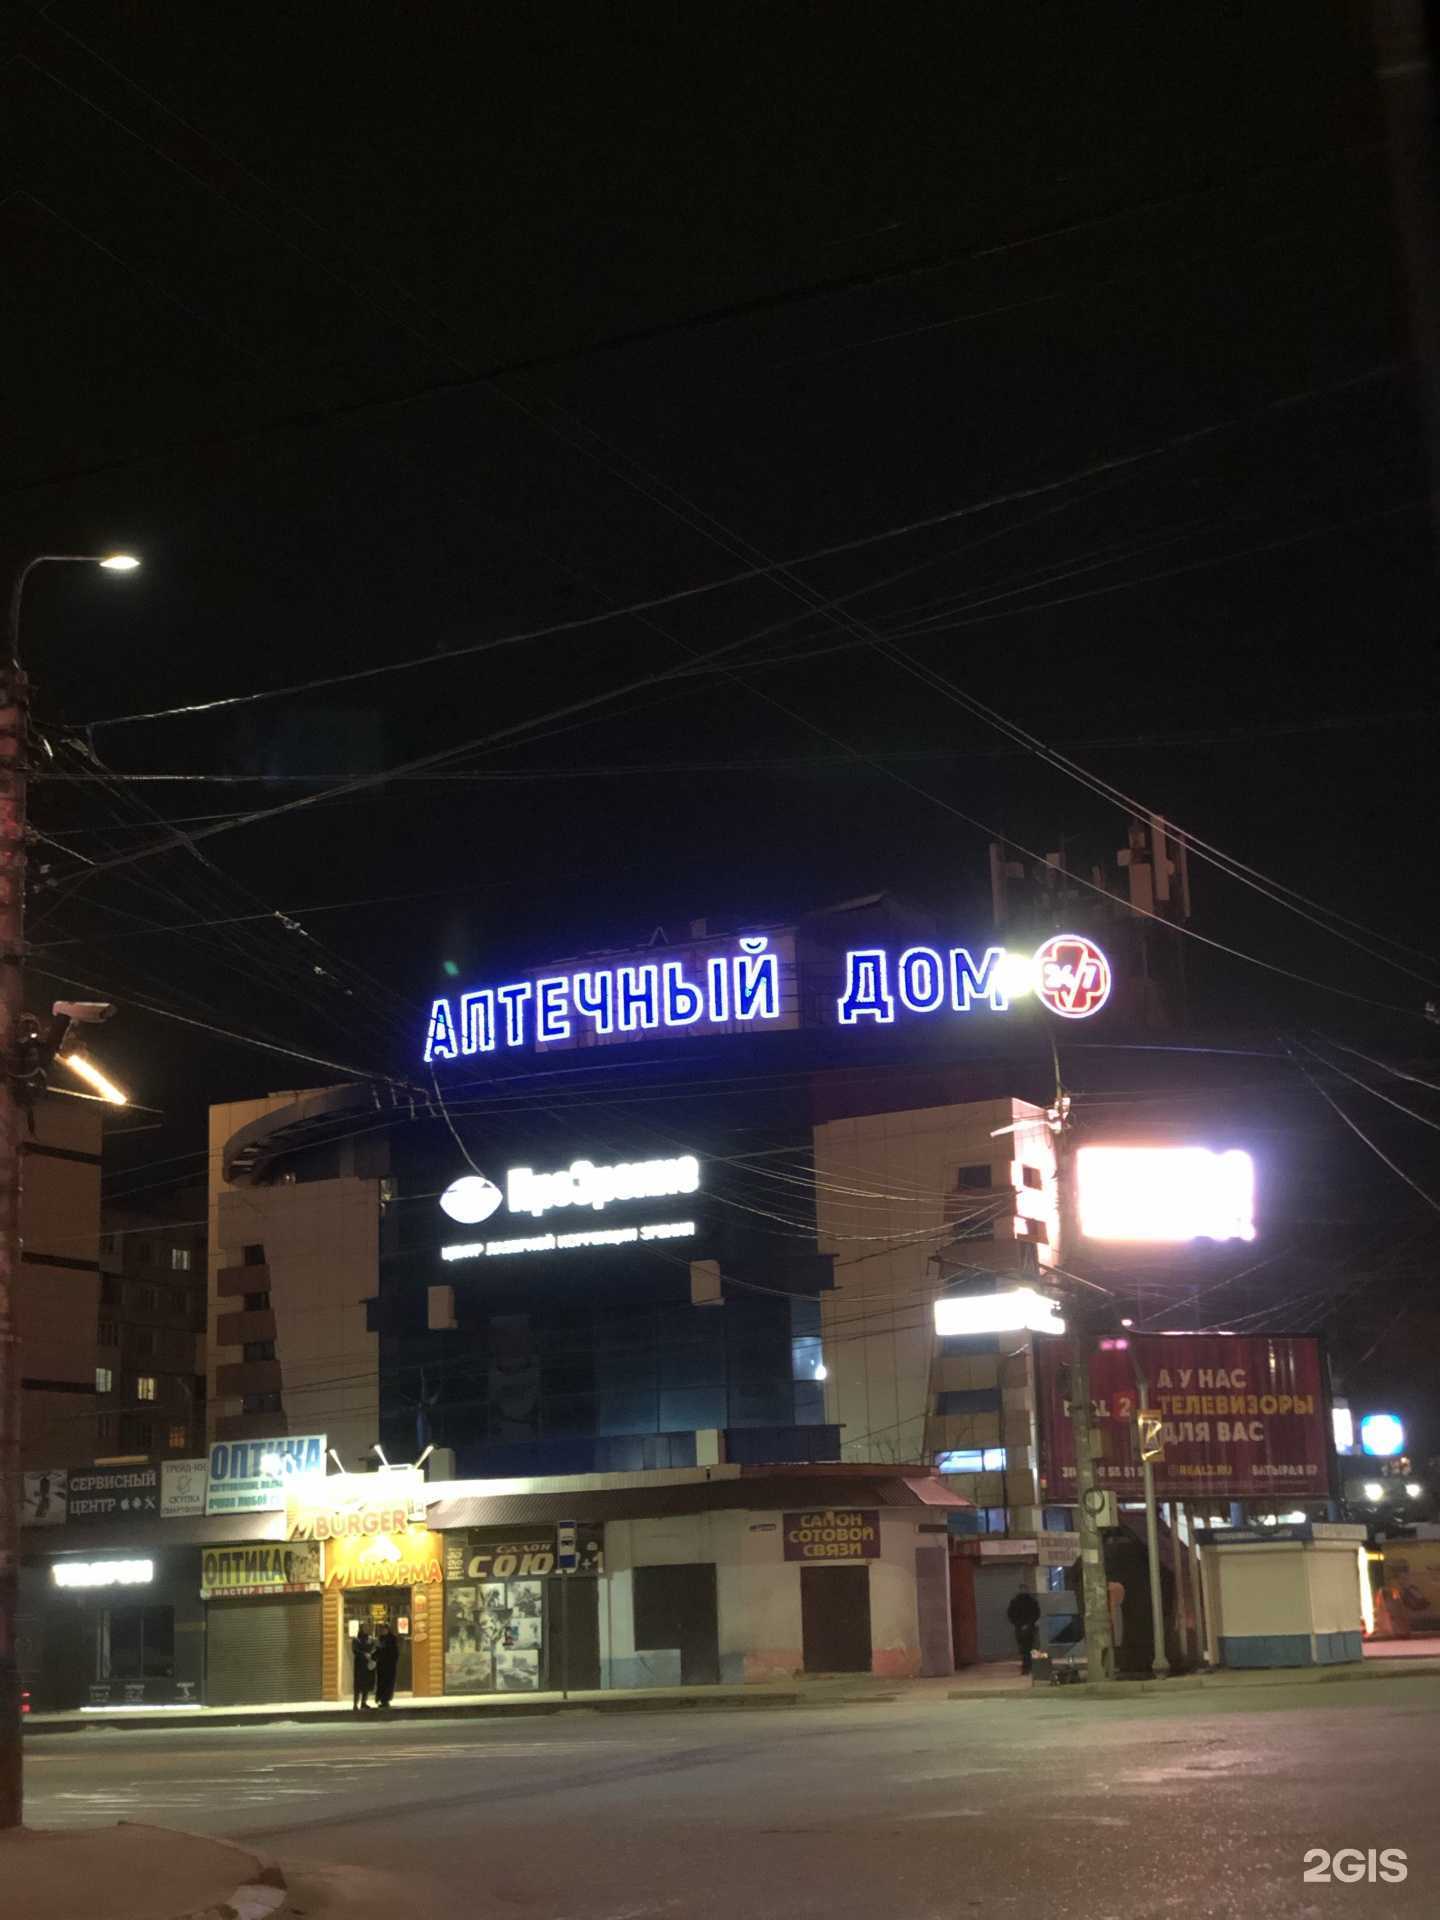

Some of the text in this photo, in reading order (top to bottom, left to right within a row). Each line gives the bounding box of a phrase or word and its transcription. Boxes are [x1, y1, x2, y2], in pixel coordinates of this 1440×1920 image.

[423, 937, 1010, 1063] АПТЕЧНЫЙ ДОМ
[1157, 1368, 1247, 1389] А У НАС
[1157, 1394, 1315, 1415] ТЕЛЕВИЗОРЫ
[1160, 1421, 1265, 1446] ДЛЯ ВАС
[69, 1471, 156, 1491] СЕРВИСНЫЙ
[69, 1499, 116, 1516] ЦЕНТР
[315, 1509, 407, 1538] BURGER
[803, 1543, 862, 1557] СВЯЗИ
[205, 1548, 284, 1586] ОПТИКА
[352, 1560, 443, 1587] ШАУРМА
